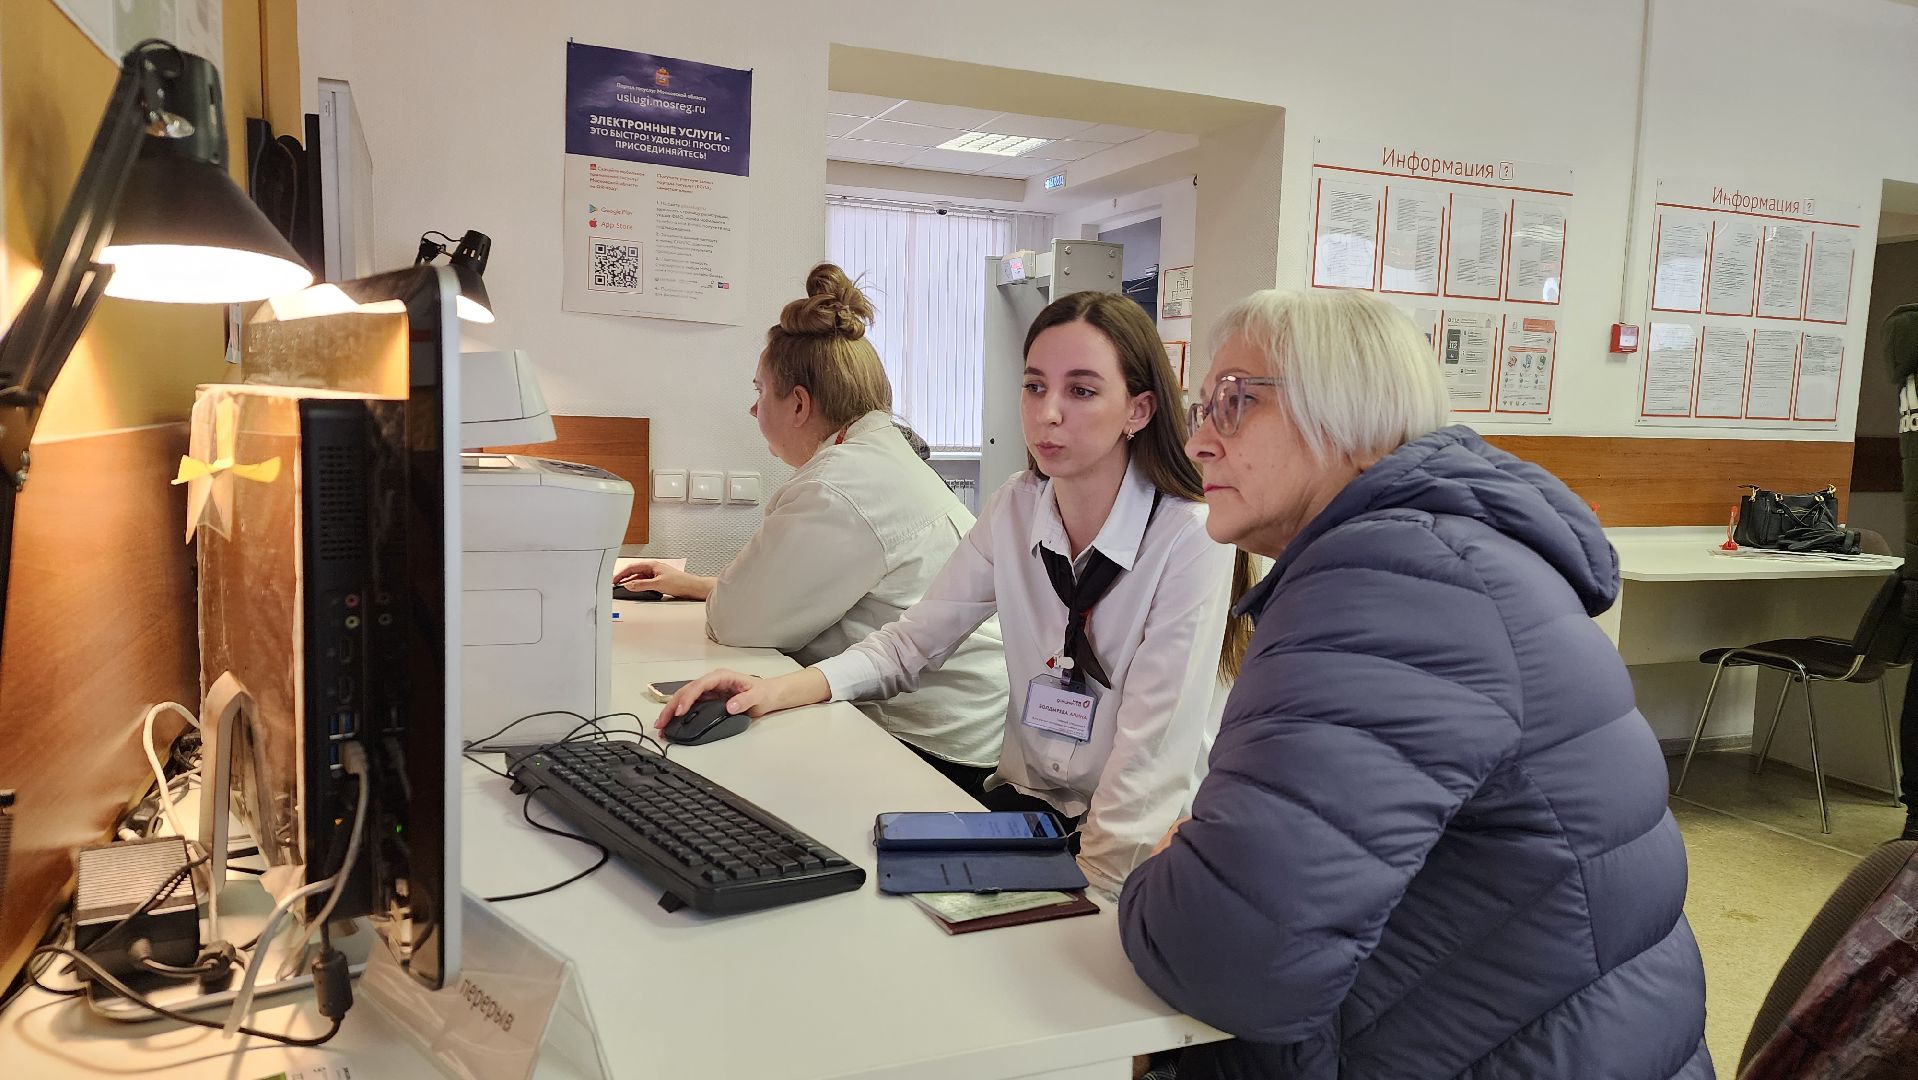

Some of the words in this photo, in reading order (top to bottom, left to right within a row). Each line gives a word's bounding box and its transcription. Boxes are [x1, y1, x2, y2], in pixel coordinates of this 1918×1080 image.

[616, 92, 706, 115] uslugi.mosreg.ru
[589, 114, 677, 135] ЭЛЕКТРОННЫЕ
[678, 127, 722, 142] УСЛУГИ
[589, 126, 609, 137] ЭТО
[609, 128, 650, 142] БЫСТРО!
[651, 135, 691, 147] УДОБНО!
[692, 141, 731, 153] ПРОСТО!
[615, 140, 707, 160] ПРИСОЕДИНЯЙТЕСЬ!
[1382, 147, 1494, 178] Информация
[600, 206, 621, 216] Google
[1712, 187, 1800, 214] Информация
[600, 221, 615, 230] App
[616, 222, 633, 231] Store
[458, 978, 516, 1033] перерыв
